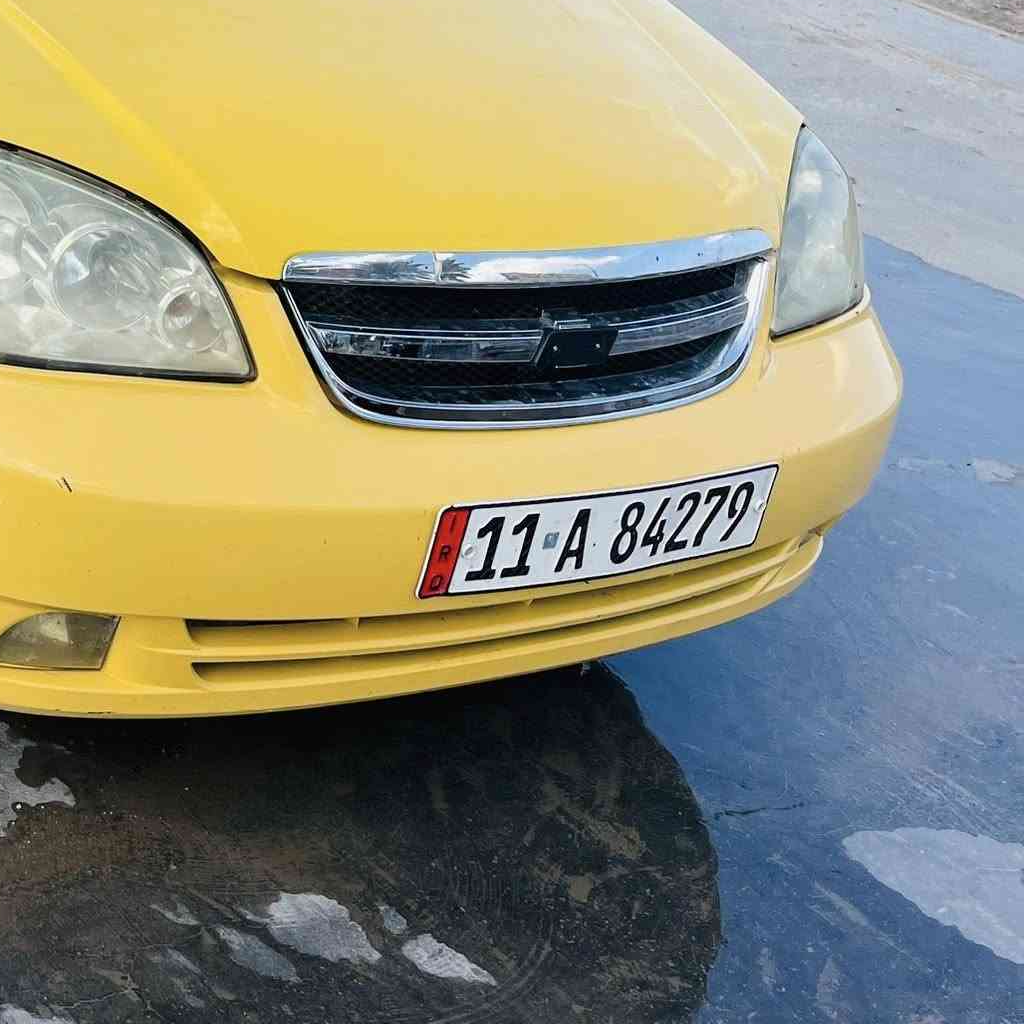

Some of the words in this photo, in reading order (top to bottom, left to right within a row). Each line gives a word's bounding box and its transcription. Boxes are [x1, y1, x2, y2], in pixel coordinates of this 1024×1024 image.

[464, 512, 541, 582] 11
[554, 508, 592, 573] A
[609, 480, 756, 565] 84279
